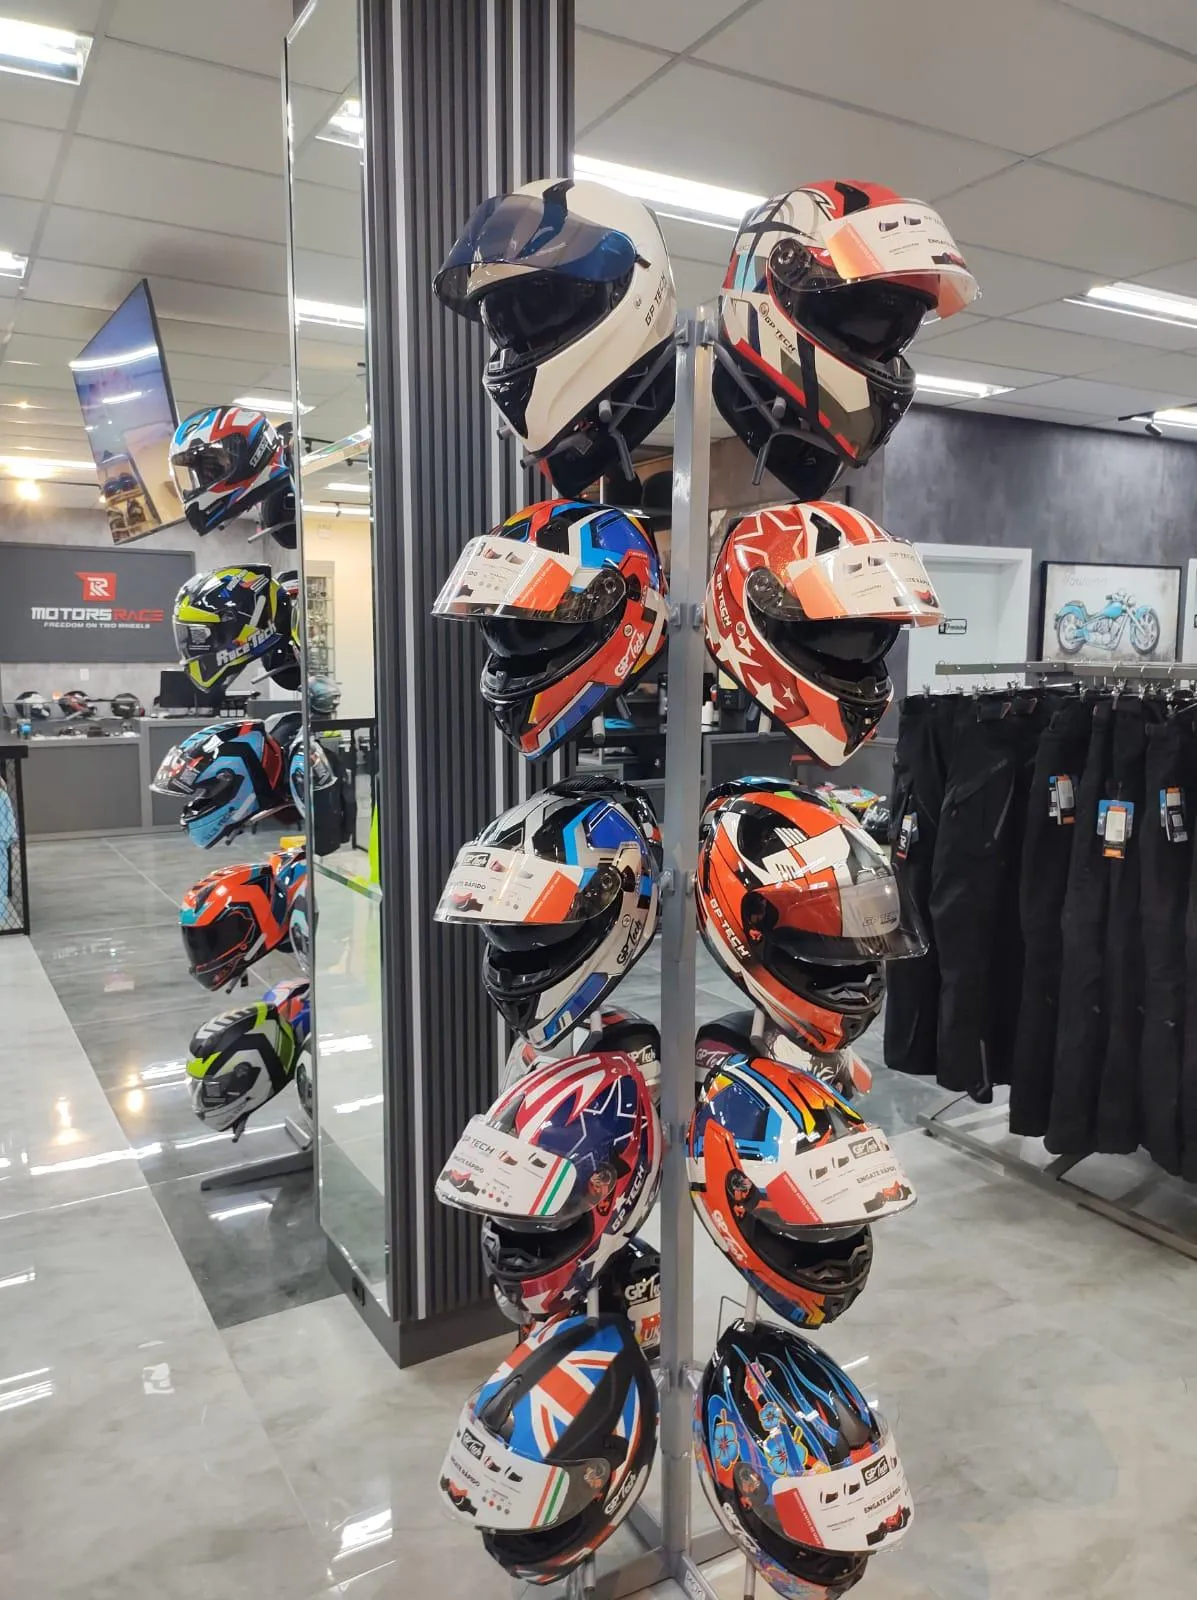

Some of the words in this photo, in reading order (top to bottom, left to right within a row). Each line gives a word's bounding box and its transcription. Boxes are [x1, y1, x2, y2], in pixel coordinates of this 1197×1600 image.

[645, 304, 655, 327] GP
[764, 316, 776, 328] GP
[775, 328, 796, 352] TECH
[716, 573, 723, 590] GP
[718, 592, 732, 629] TECH
[43, 621, 85, 629] FREEDOM
[614, 655, 631, 678] GP
[710, 898, 724, 918] GP
[722, 919, 750, 957] TECH
[616, 942, 630, 964] GP
[626, 918, 643, 946] Tech
[471, 1137, 496, 1155] TECH
[856, 1169, 882, 1184] ENGATE
[611, 1208, 626, 1232] GP
[625, 1164, 645, 1206] TECH
[625, 1282, 647, 1301] GP
[863, 1466, 880, 1481] GP
[876, 1457, 889, 1476] Tech
[604, 1494, 621, 1516] GP
[863, 1497, 887, 1514] ENGATE
